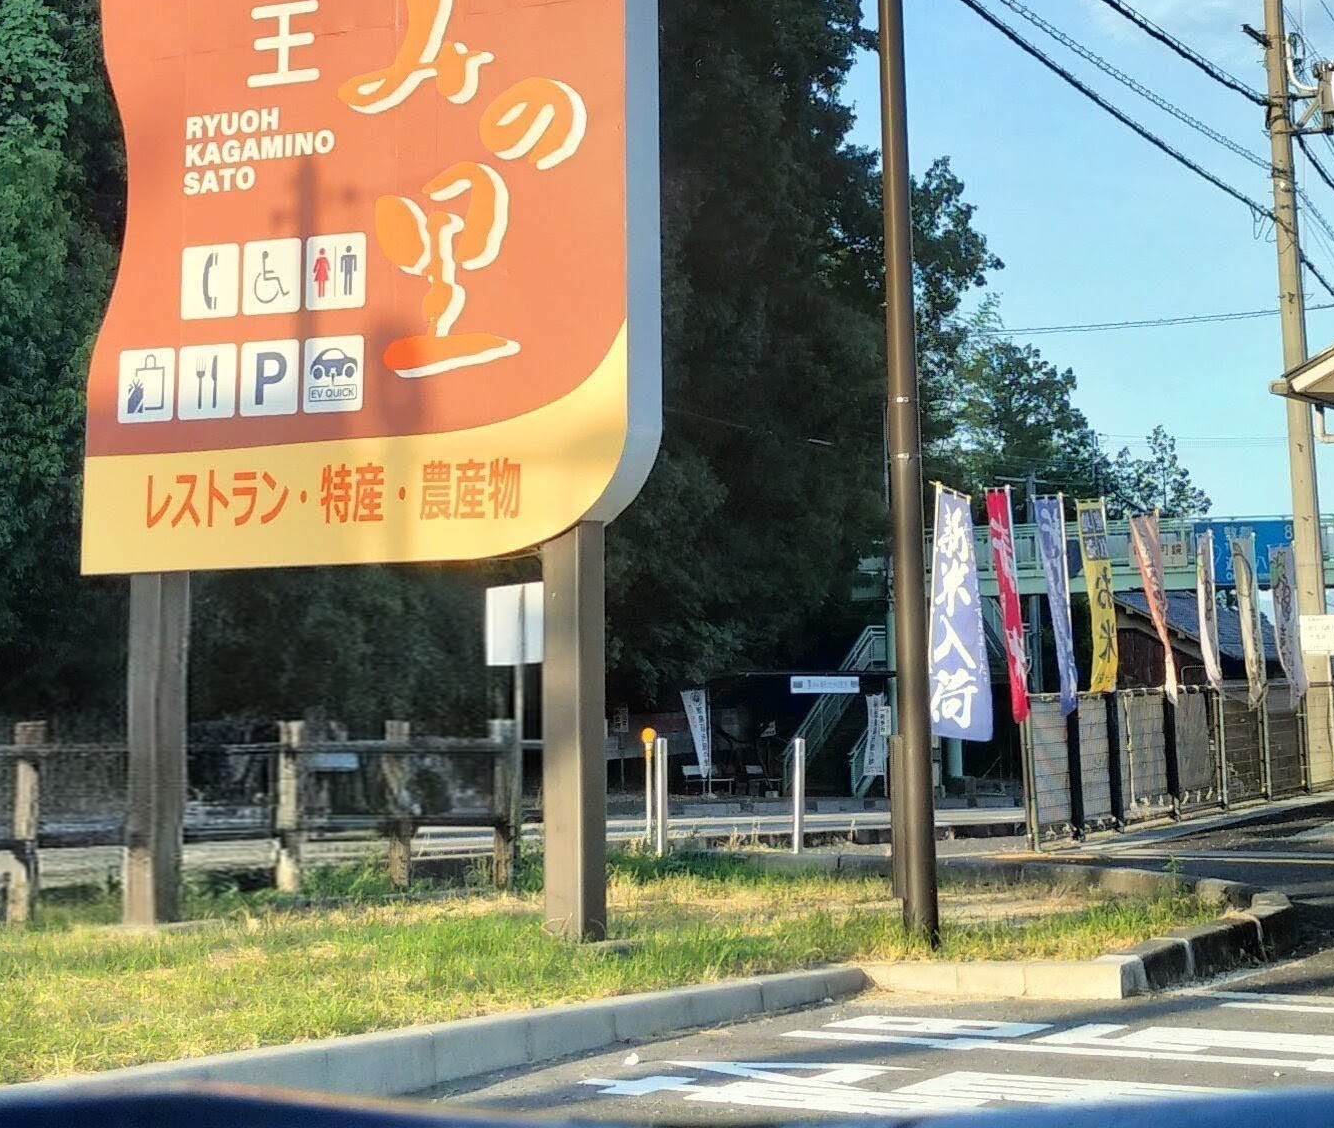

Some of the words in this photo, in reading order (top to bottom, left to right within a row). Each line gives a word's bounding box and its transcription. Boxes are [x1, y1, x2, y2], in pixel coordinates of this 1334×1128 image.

[185, 107, 280, 140] RYUOH
[184, 129, 336, 168] KAGAMINO
[183, 165, 256, 196] SATO
[255, 351, 288, 406] P
[311, 389, 324, 399] EV
[325, 387, 355, 398] QUICK
[930, 503, 979, 729] 新米入荷
